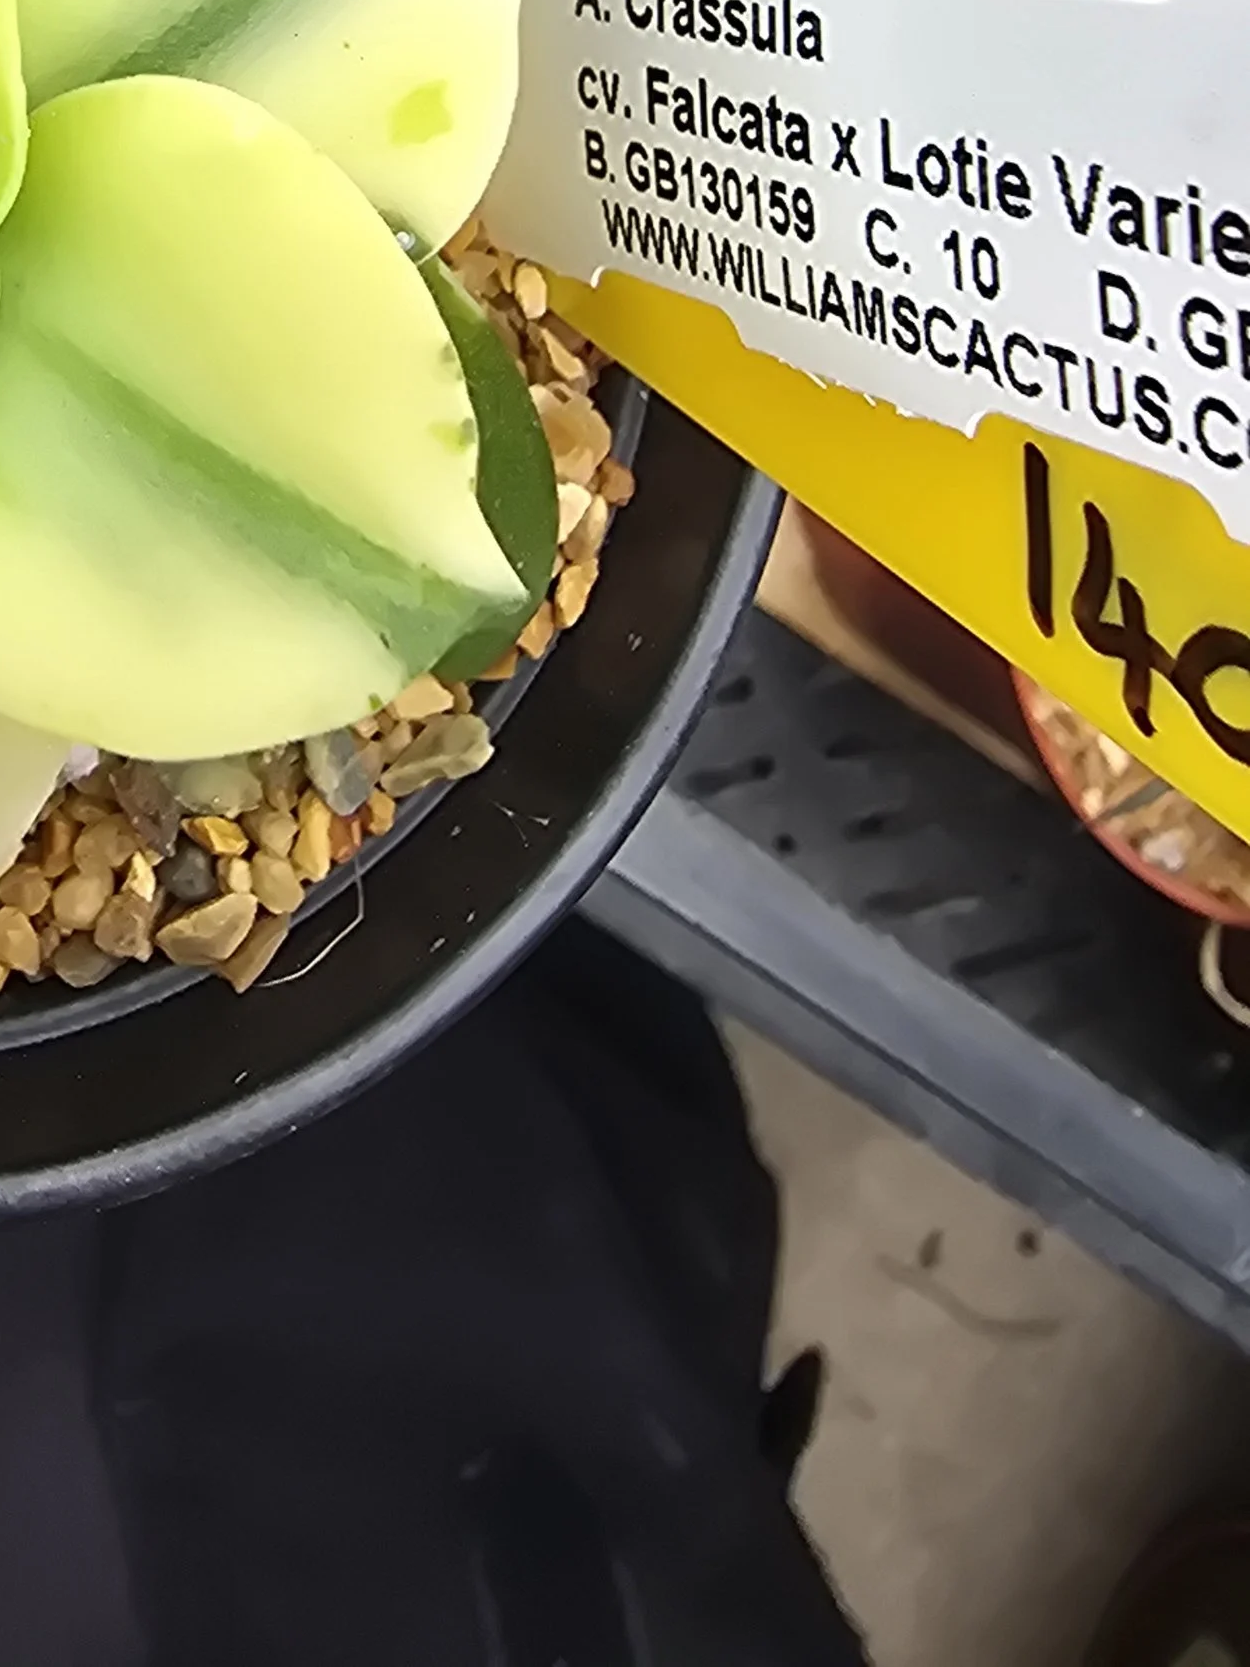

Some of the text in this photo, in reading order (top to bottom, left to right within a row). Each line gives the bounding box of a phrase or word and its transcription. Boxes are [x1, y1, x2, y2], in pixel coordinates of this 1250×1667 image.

[578, 66, 632, 119] cv.
[646, 66, 813, 165] Falcata
[831, 122, 861, 177] x
[880, 118, 1032, 219] Lotie
[584, 129, 1250, 381] B. GB130159 C. 10 D. G
[602, 198, 1250, 469] WWW.WILLIAMSCACTUS.C
